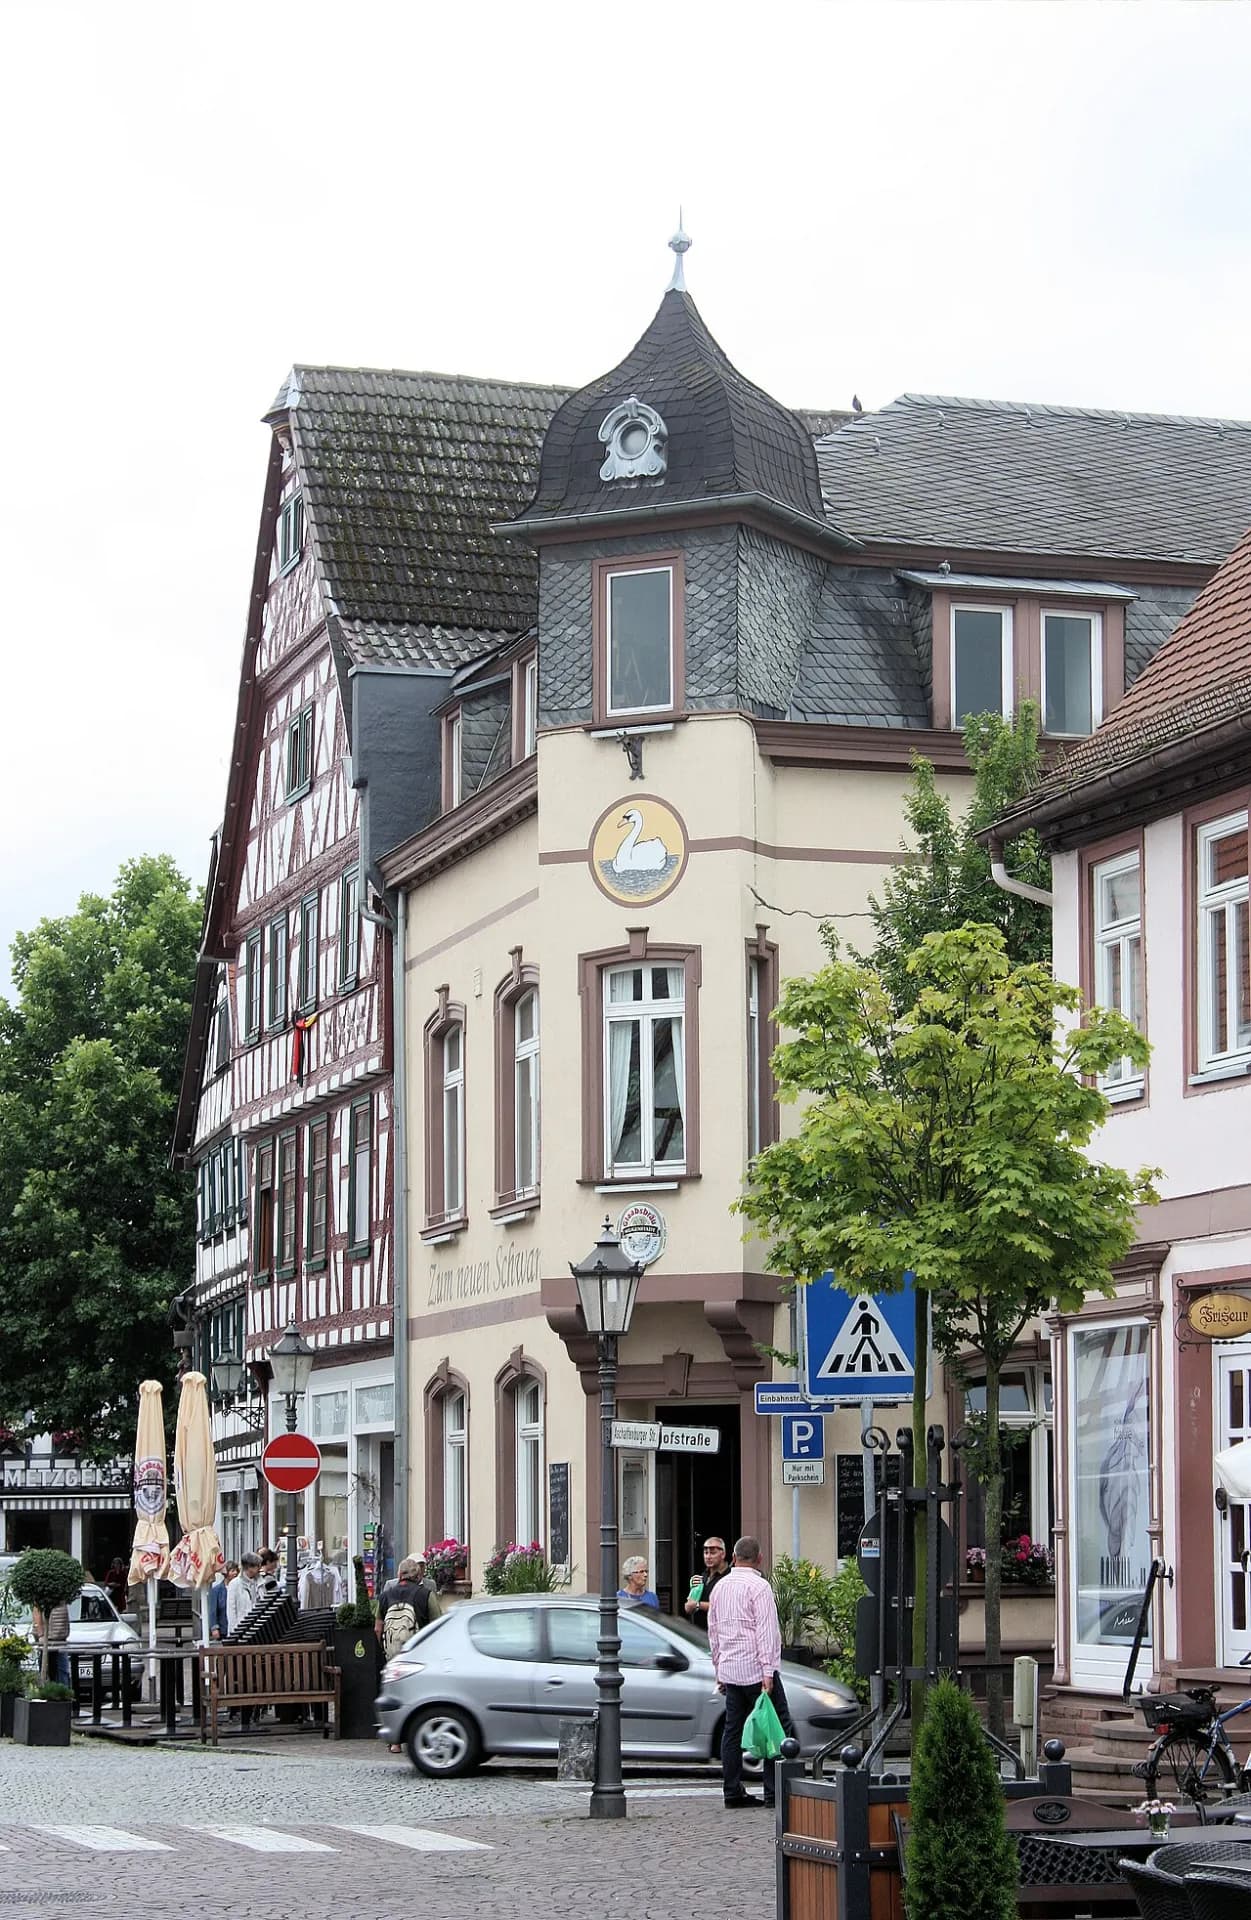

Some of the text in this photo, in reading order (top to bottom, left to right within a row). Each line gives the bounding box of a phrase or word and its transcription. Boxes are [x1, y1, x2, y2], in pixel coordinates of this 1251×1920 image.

[428, 1263, 453, 1306] Zum
[456, 1260, 490, 1299] neuen
[760, 1394, 801, 1403] Einbahnstr
[663, 1431, 711, 1446] ofstraße
[792, 1421, 814, 1454] P
[792, 1464, 815, 1472] Nur mit
[787, 1473, 820, 1482] Parkschein
